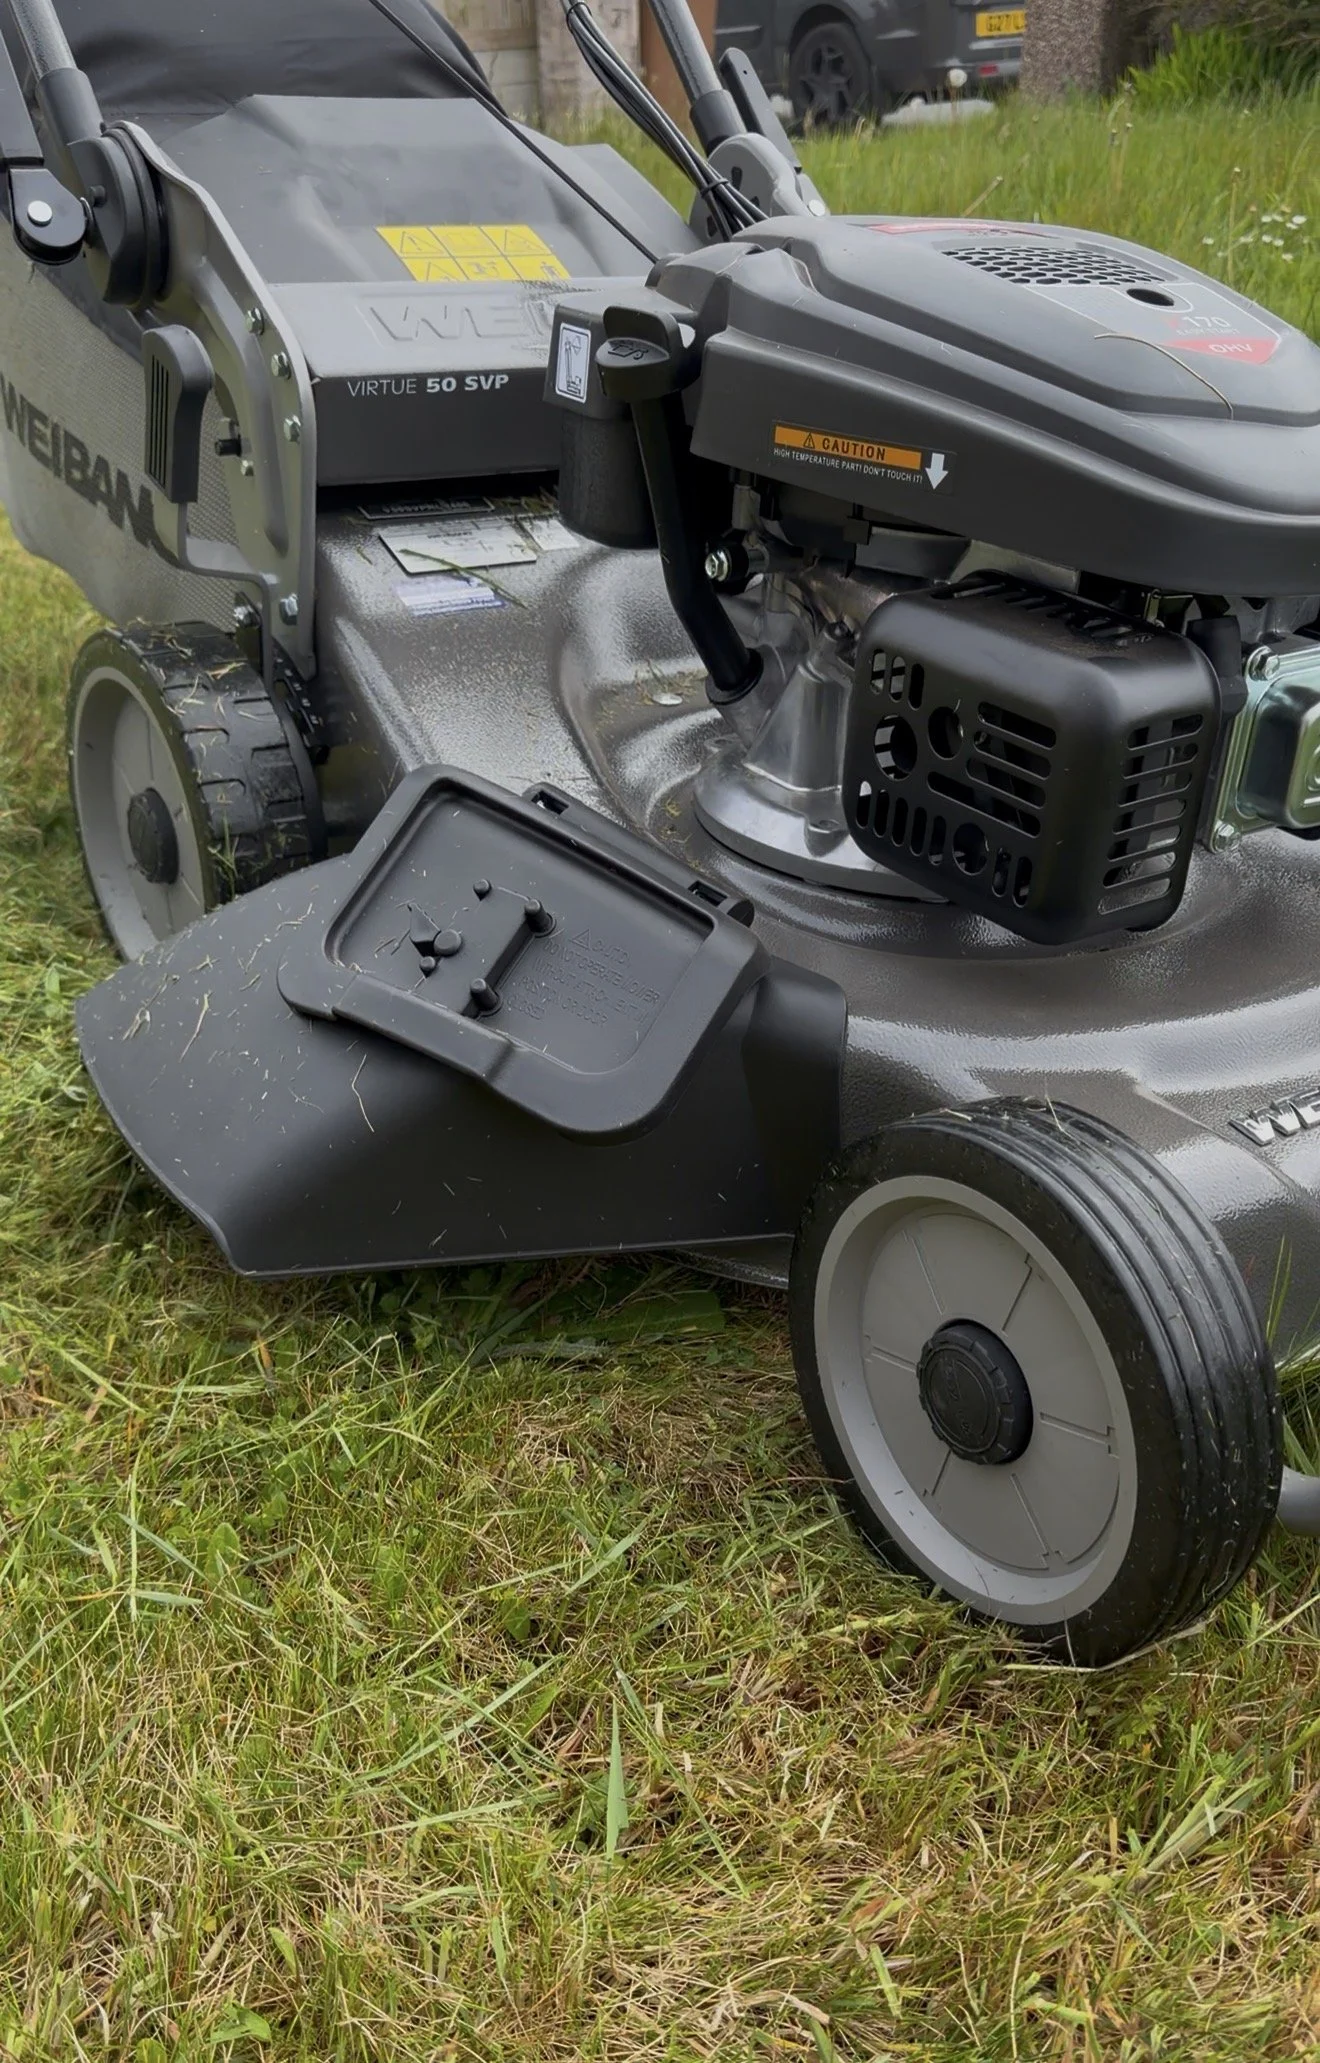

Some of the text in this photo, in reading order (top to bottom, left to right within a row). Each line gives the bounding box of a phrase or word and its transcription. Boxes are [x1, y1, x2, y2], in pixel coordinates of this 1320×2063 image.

[1208, 343, 1253, 353] OHV
[347, 374, 509, 397] VIRTUE 50 SVP
[822, 437, 886, 461] CAUTION
[773, 447, 790, 459] HIGH
[791, 453, 840, 469] TEMPERATURE
[841, 461, 862, 473] PART!
[863, 465, 885, 478] DON'T
[887, 469, 912, 483] TOUCH
